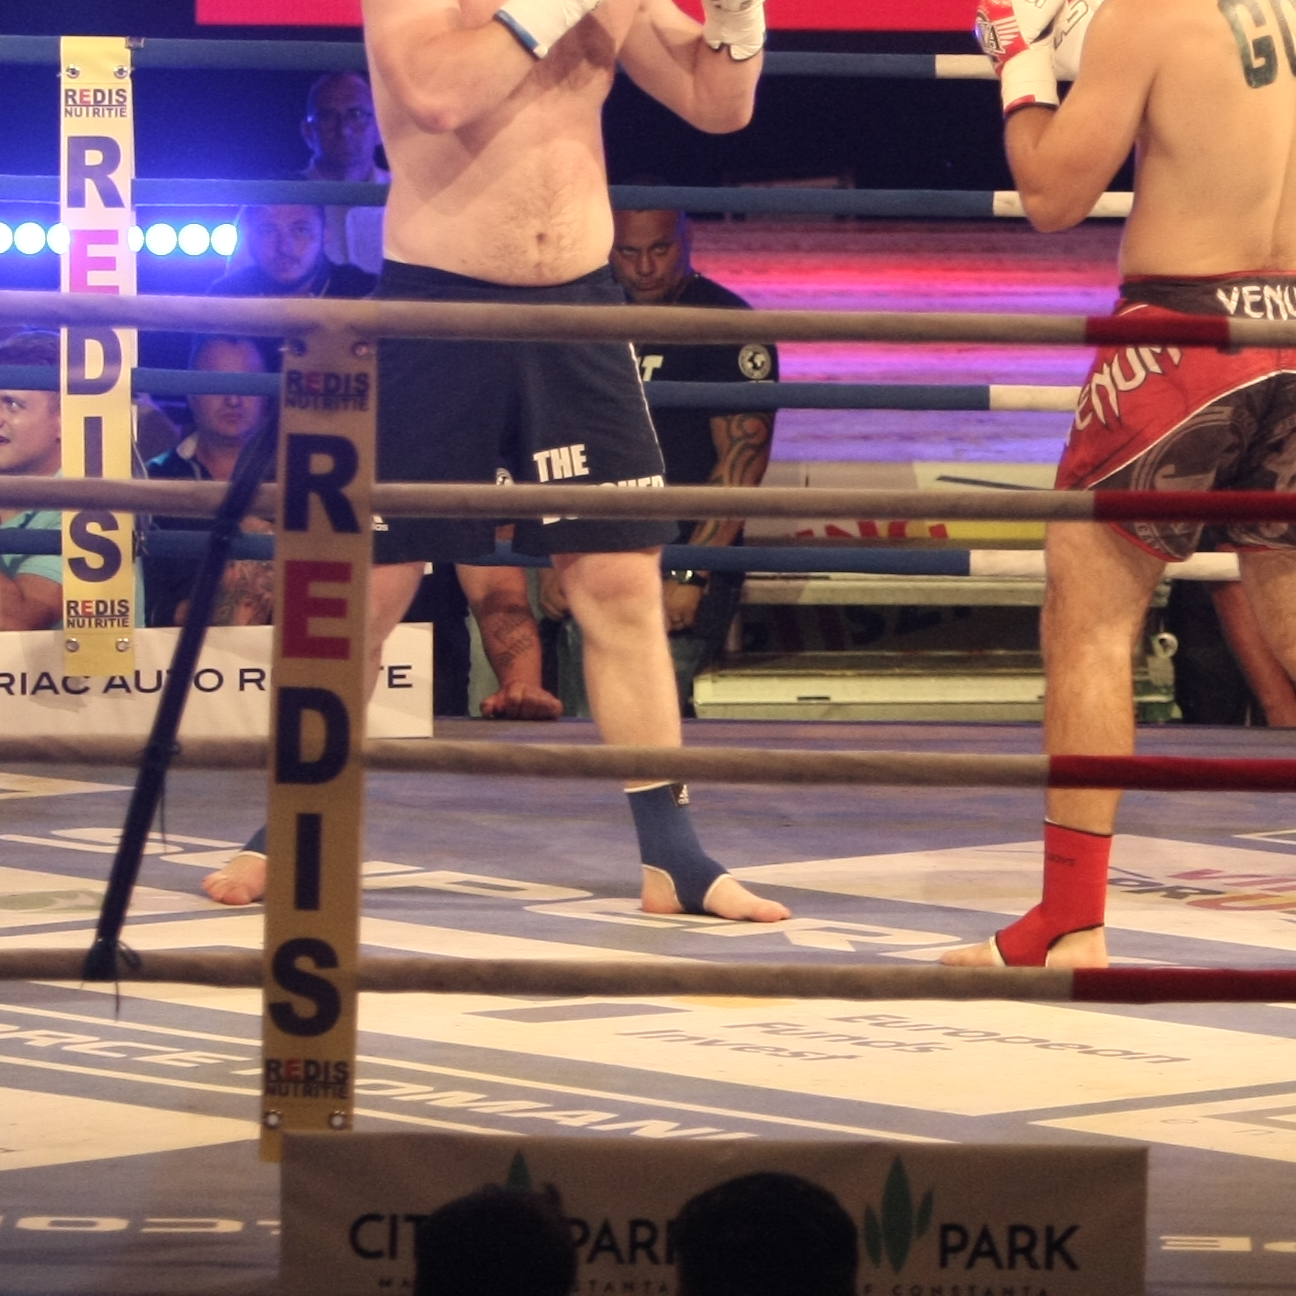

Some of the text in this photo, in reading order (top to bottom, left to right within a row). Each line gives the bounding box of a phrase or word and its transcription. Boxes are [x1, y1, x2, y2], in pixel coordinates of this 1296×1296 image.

[65, 89, 127, 104] REDIS
[65, 106, 127, 118] NUTRITIE
[286, 370, 369, 396] REDIS
[1067, 346, 1182, 444] ENUM
[286, 396, 369, 411] NUTRITIE
[533, 444, 589, 482] THE
[67, 599, 129, 616] REDIS
[67, 617, 129, 628] NUTRITIE
[104, 668, 224, 695] AUO
[616, 1028, 863, 1062] Invest
[726, 1021, 954, 1055] Funds
[828, 1014, 1192, 1065] European
[265, 1058, 349, 1084] REDIS
[265, 1084, 349, 1099] NUTRITIE
[349, 1213, 431, 1260] CIT
[938, 1222, 1080, 1272] PARK
